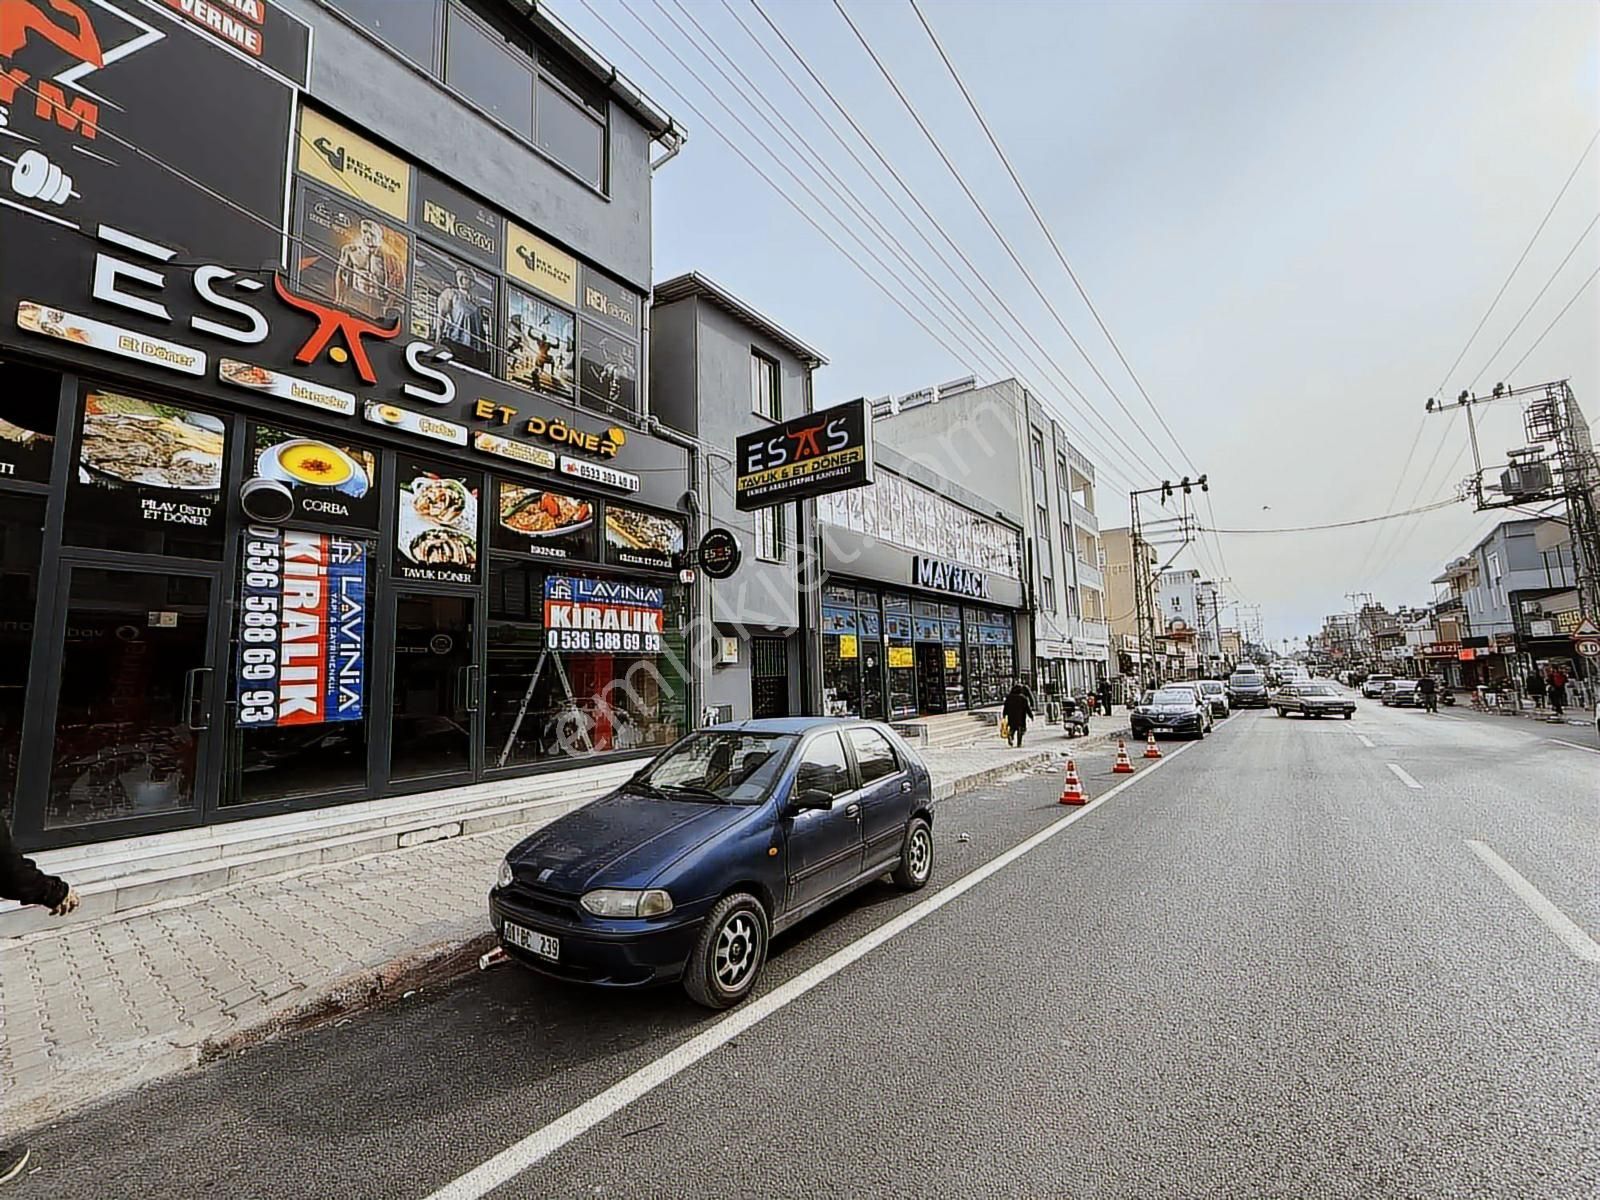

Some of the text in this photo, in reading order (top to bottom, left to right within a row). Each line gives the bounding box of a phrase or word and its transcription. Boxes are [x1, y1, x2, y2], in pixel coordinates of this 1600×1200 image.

[179, 0, 258, 51] VERME
[346, 163, 396, 193] FITNESS
[424, 200, 456, 237] REX
[455, 222, 495, 254] GYM
[476, 399, 518, 425] ET
[527, 417, 618, 458] DÖNER
[740, 451, 861, 488] TAVUK & ET DÖNER
[144, 510, 162, 519] ET
[302, 499, 349, 516] ÇORBA
[246, 540, 280, 588] 536
[402, 567, 436, 580] TAVUK
[918, 558, 992, 598] MAYBACK
[243, 596, 278, 643] 588
[279, 529, 328, 719] KİRALIK
[550, 603, 660, 633] KİRALIK
[561, 630, 590, 650] 536
[595, 632, 621, 650] 588
[623, 633, 640, 651] 69
[644, 634, 660, 651] 93
[242, 648, 277, 681] 69
[240, 689, 275, 724] 93
[540, 936, 558, 957] 239
